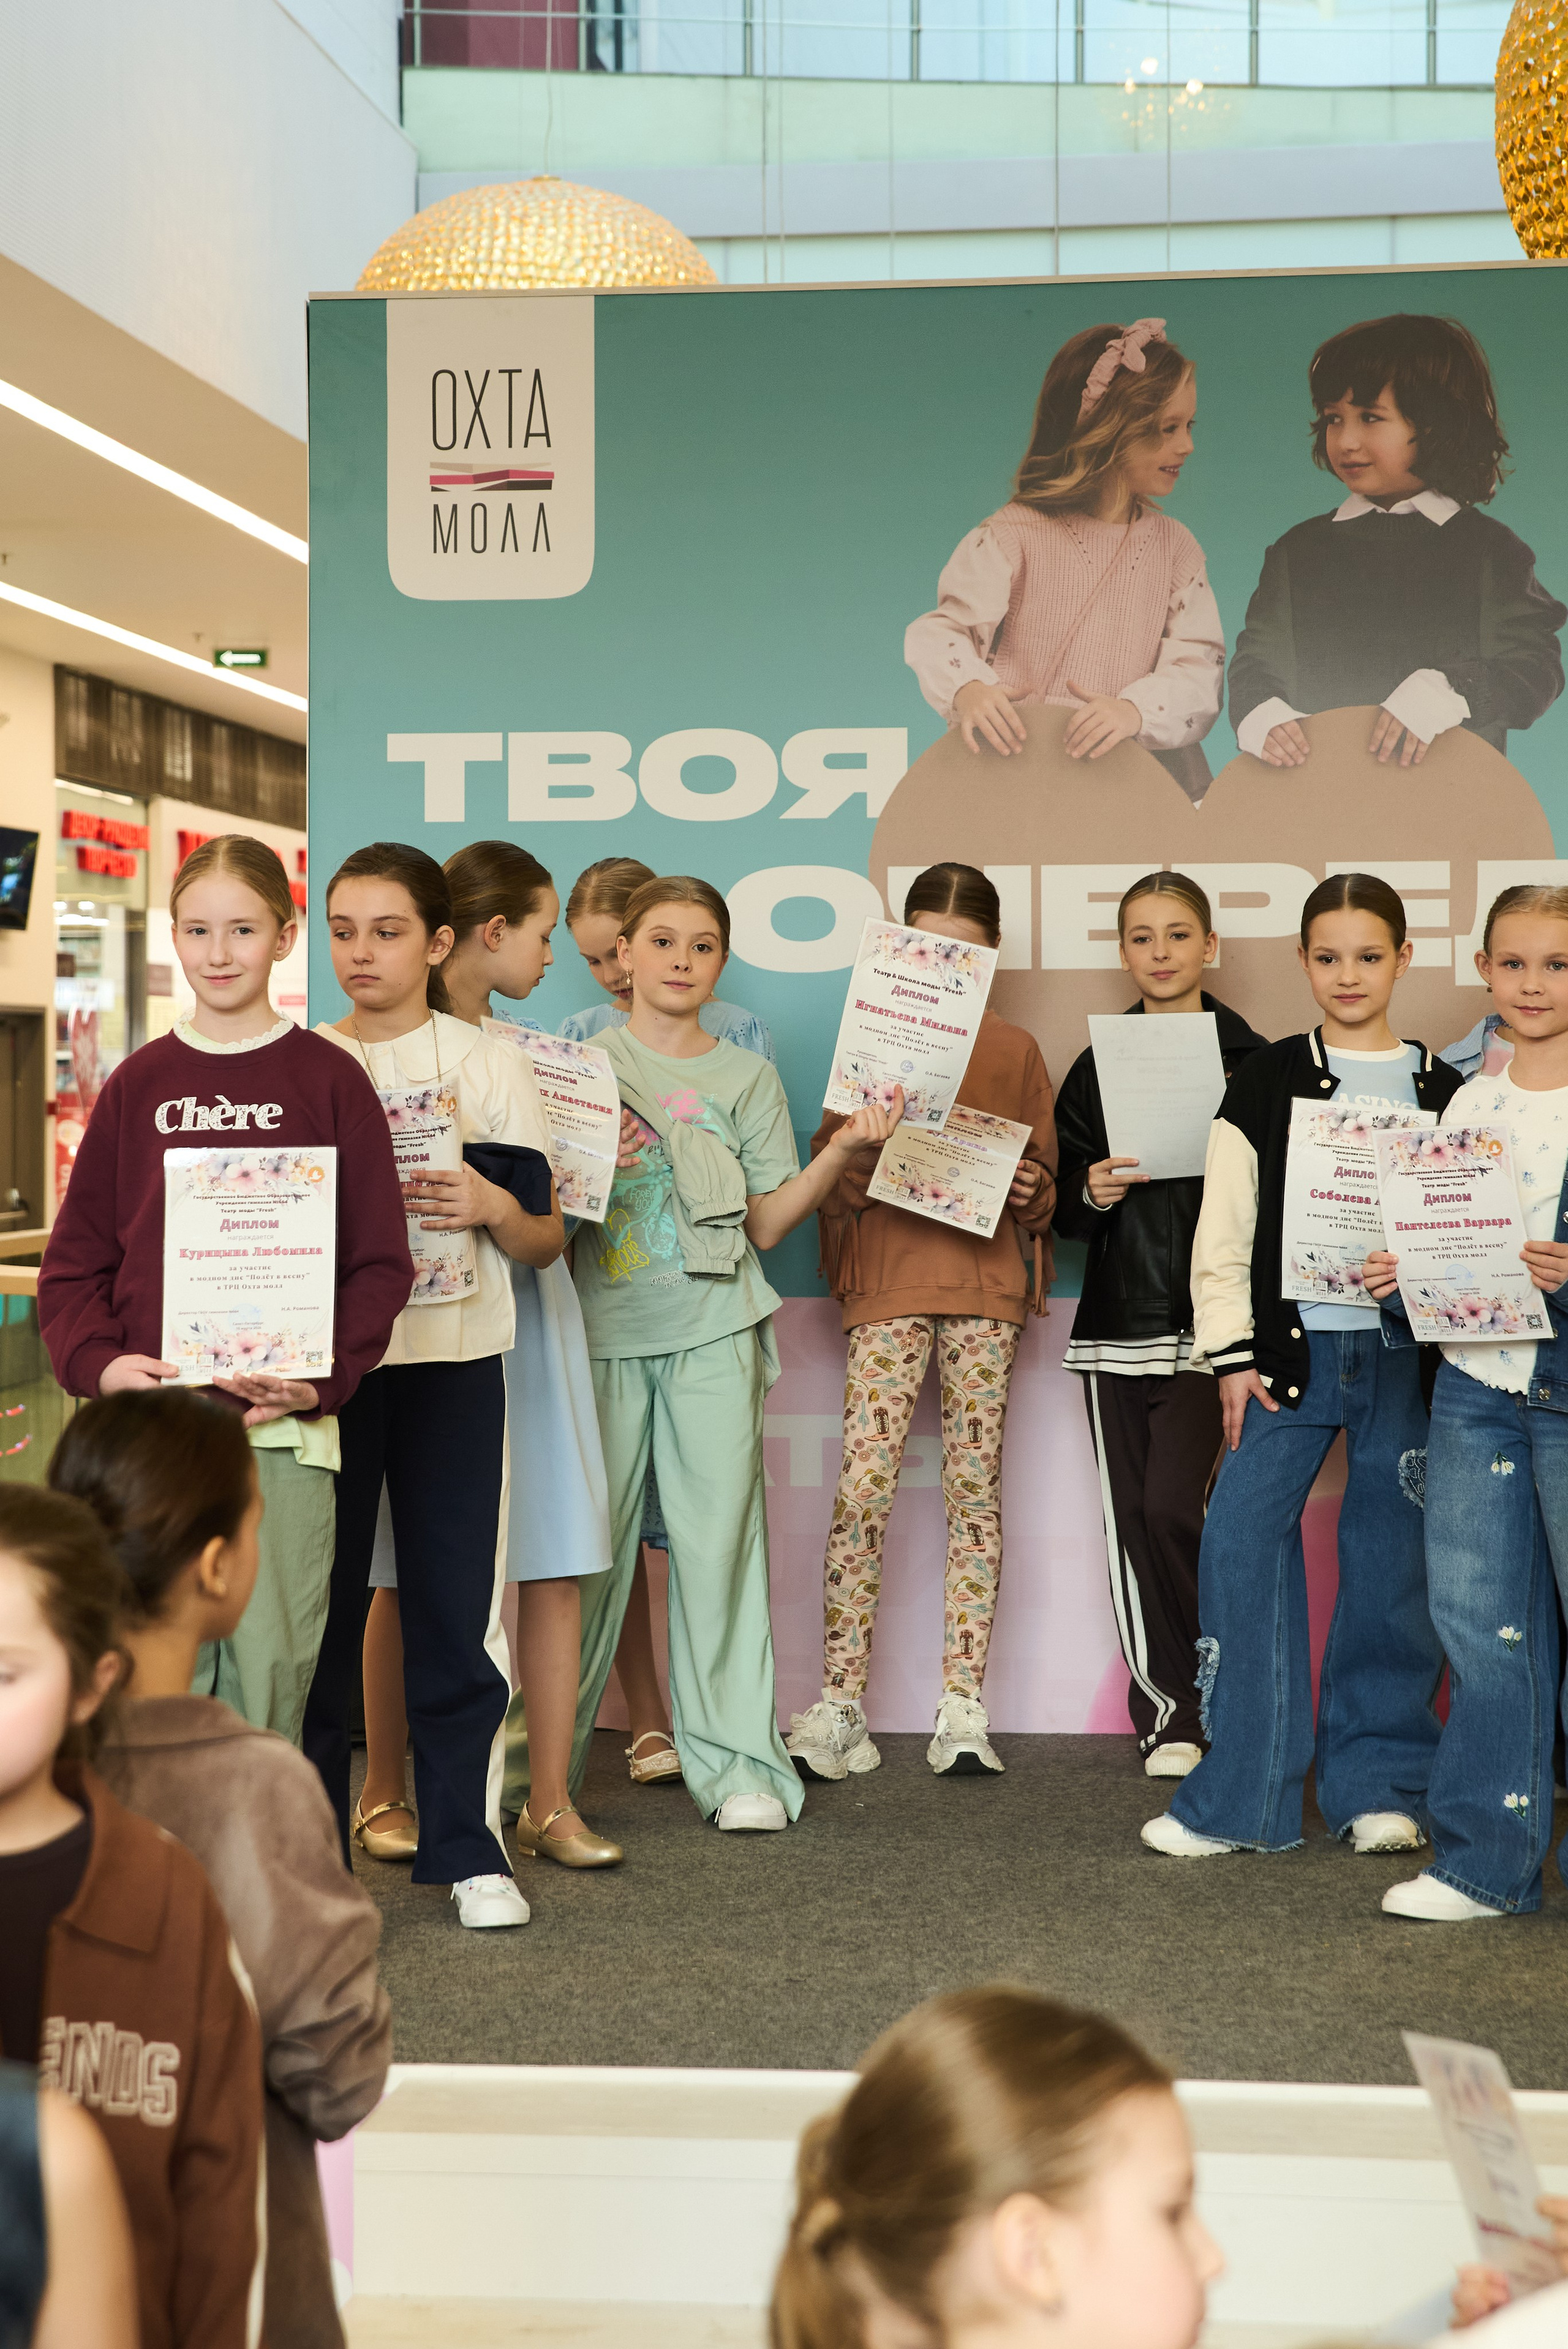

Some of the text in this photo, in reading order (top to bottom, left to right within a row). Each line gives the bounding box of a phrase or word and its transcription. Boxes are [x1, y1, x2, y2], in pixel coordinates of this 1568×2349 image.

[430, 368, 553, 451] ОХТА
[431, 502, 552, 554] МОЛЛ
[386, 728, 908, 823] ТВОЯ
[873, 968, 891, 978] Театр
[898, 975, 920, 984] Школа
[921, 981, 941, 990] моды
[891, 985, 939, 1005] Диплом
[895, 1000, 932, 1012] награждается
[855, 1000, 968, 1036] Игнатьева Милана
[865, 1026, 888, 1036] модном
[898, 1027, 924, 1037] участие
[534, 1068, 578, 1085] Диплом
[552, 1091, 612, 1115] Анастасия
[155, 1095, 283, 1134] Chère
[395, 1153, 429, 1164] плом
[1334, 1166, 1377, 1180] Дипло
[1310, 1189, 1371, 1204] Соболева
[1423, 1193, 1471, 1205] Диплом
[220, 1219, 279, 1232] Диплом
[1395, 1218, 1512, 1231] Пантелеева Варвара
[179, 1246, 323, 1260] Курицына Любомила
